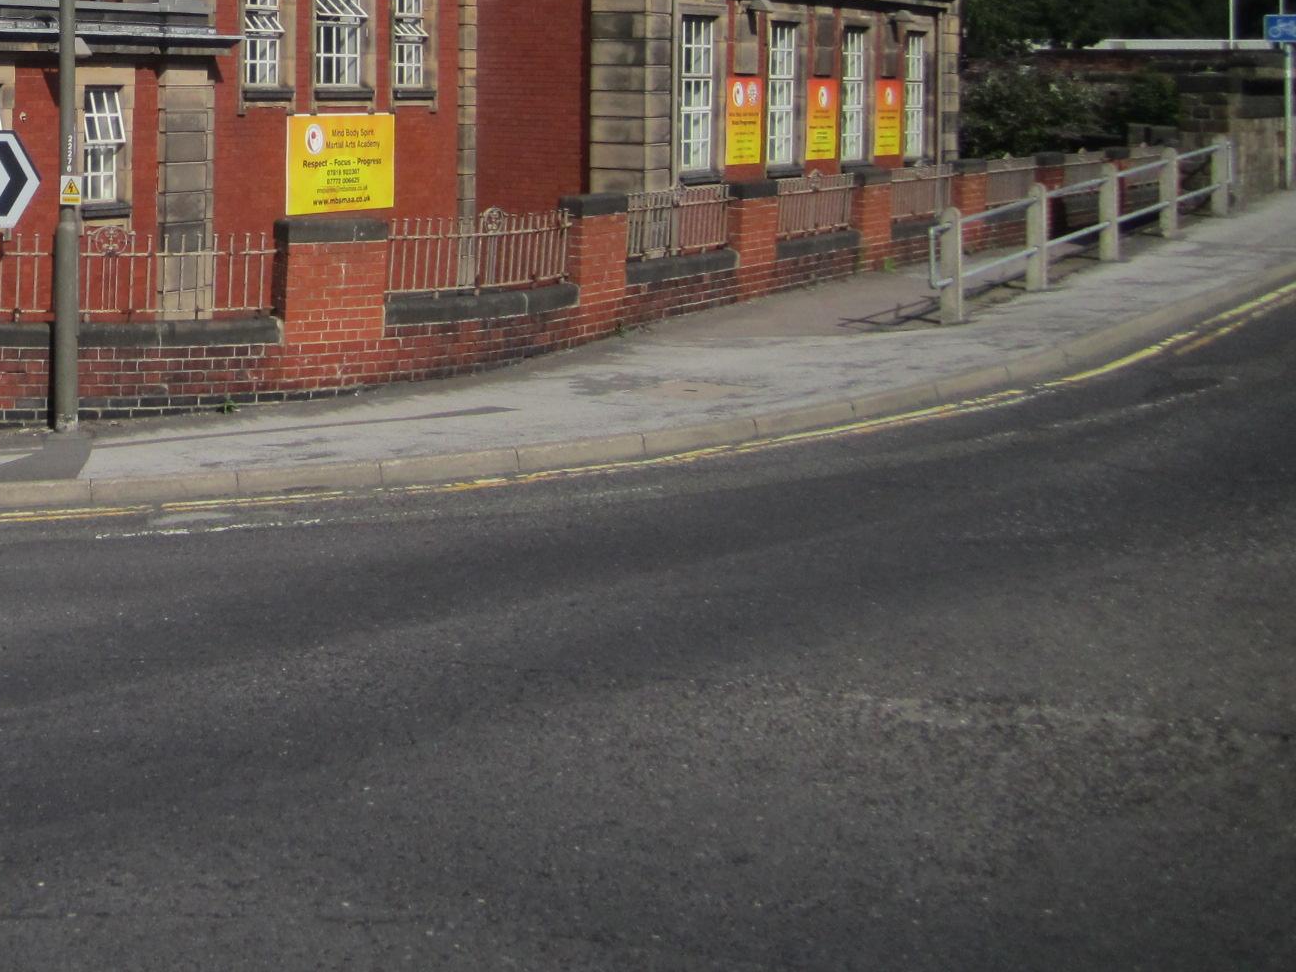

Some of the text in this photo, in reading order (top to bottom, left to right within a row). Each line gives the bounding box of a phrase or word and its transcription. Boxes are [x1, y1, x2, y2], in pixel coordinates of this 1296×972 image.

[303, 160, 327, 169] Respect
[334, 158, 351, 166] Focus
[357, 158, 381, 167] Progress
